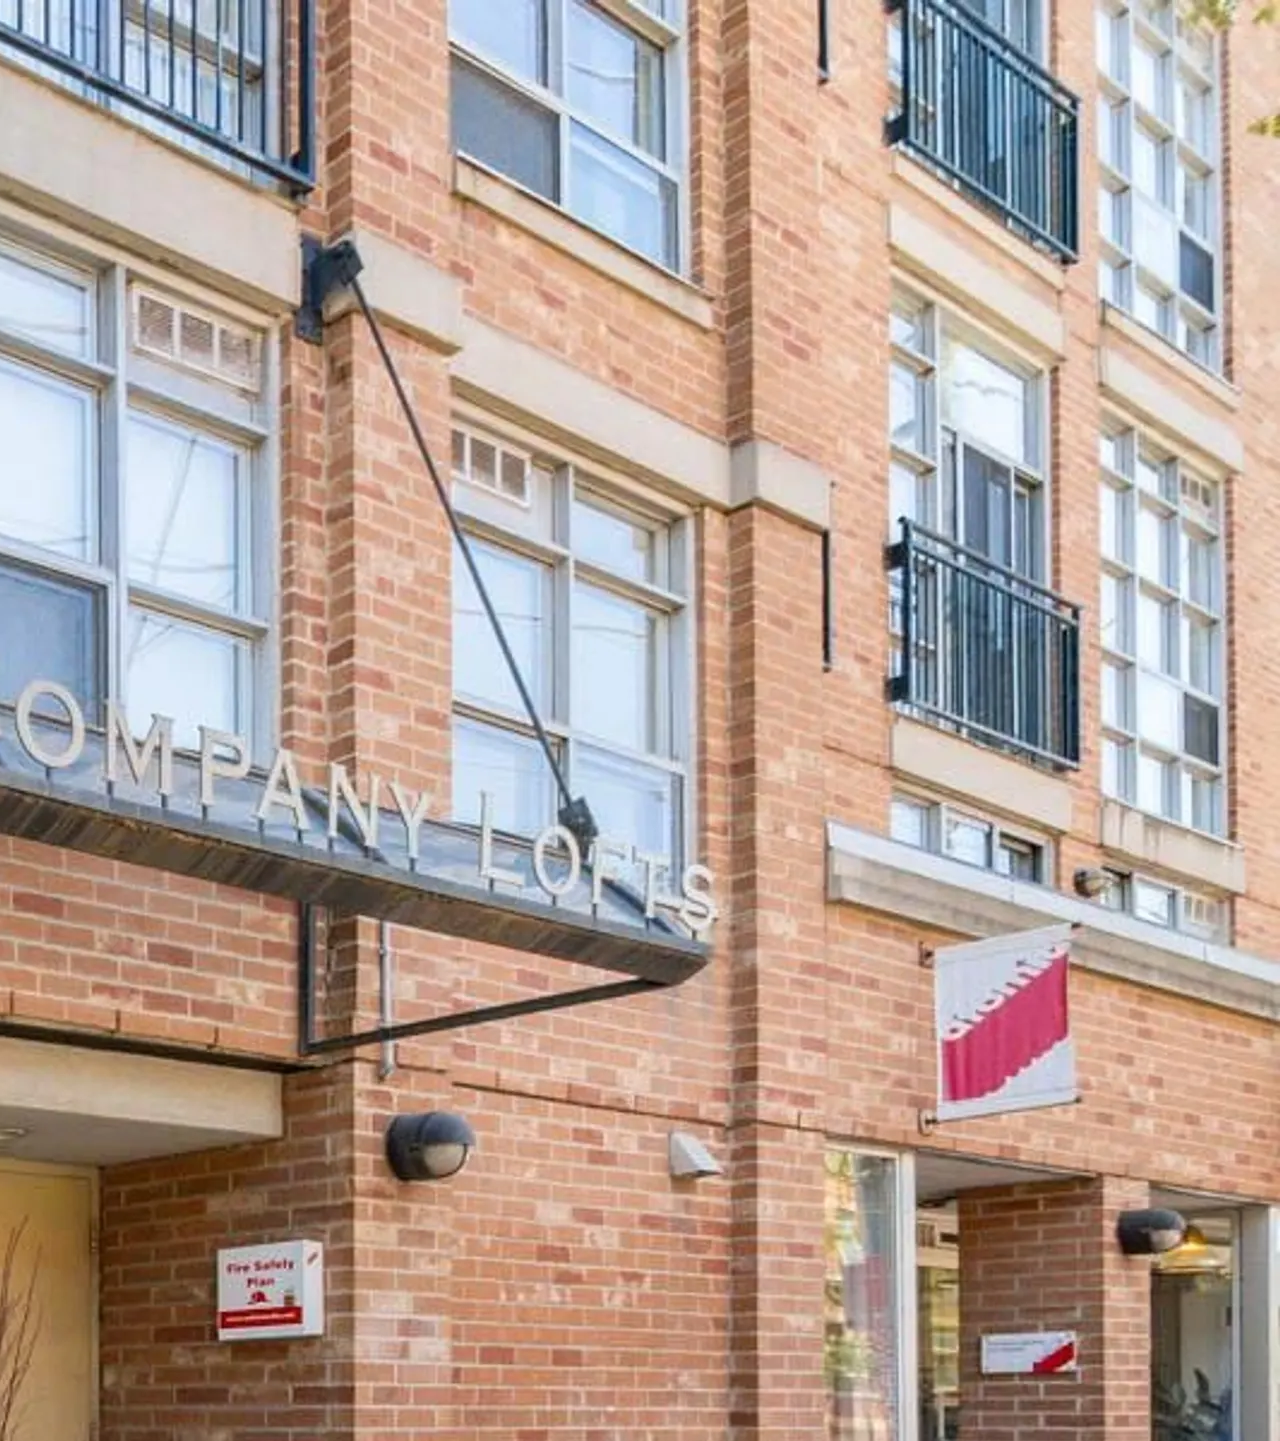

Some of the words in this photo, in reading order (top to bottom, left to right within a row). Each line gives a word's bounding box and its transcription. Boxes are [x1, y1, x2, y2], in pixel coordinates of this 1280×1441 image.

[478, 790, 719, 930] LOFTS
[227, 1263, 250, 1274] Fire
[254, 1259, 294, 1271] Safety
[246, 1277, 275, 1288] Plan
